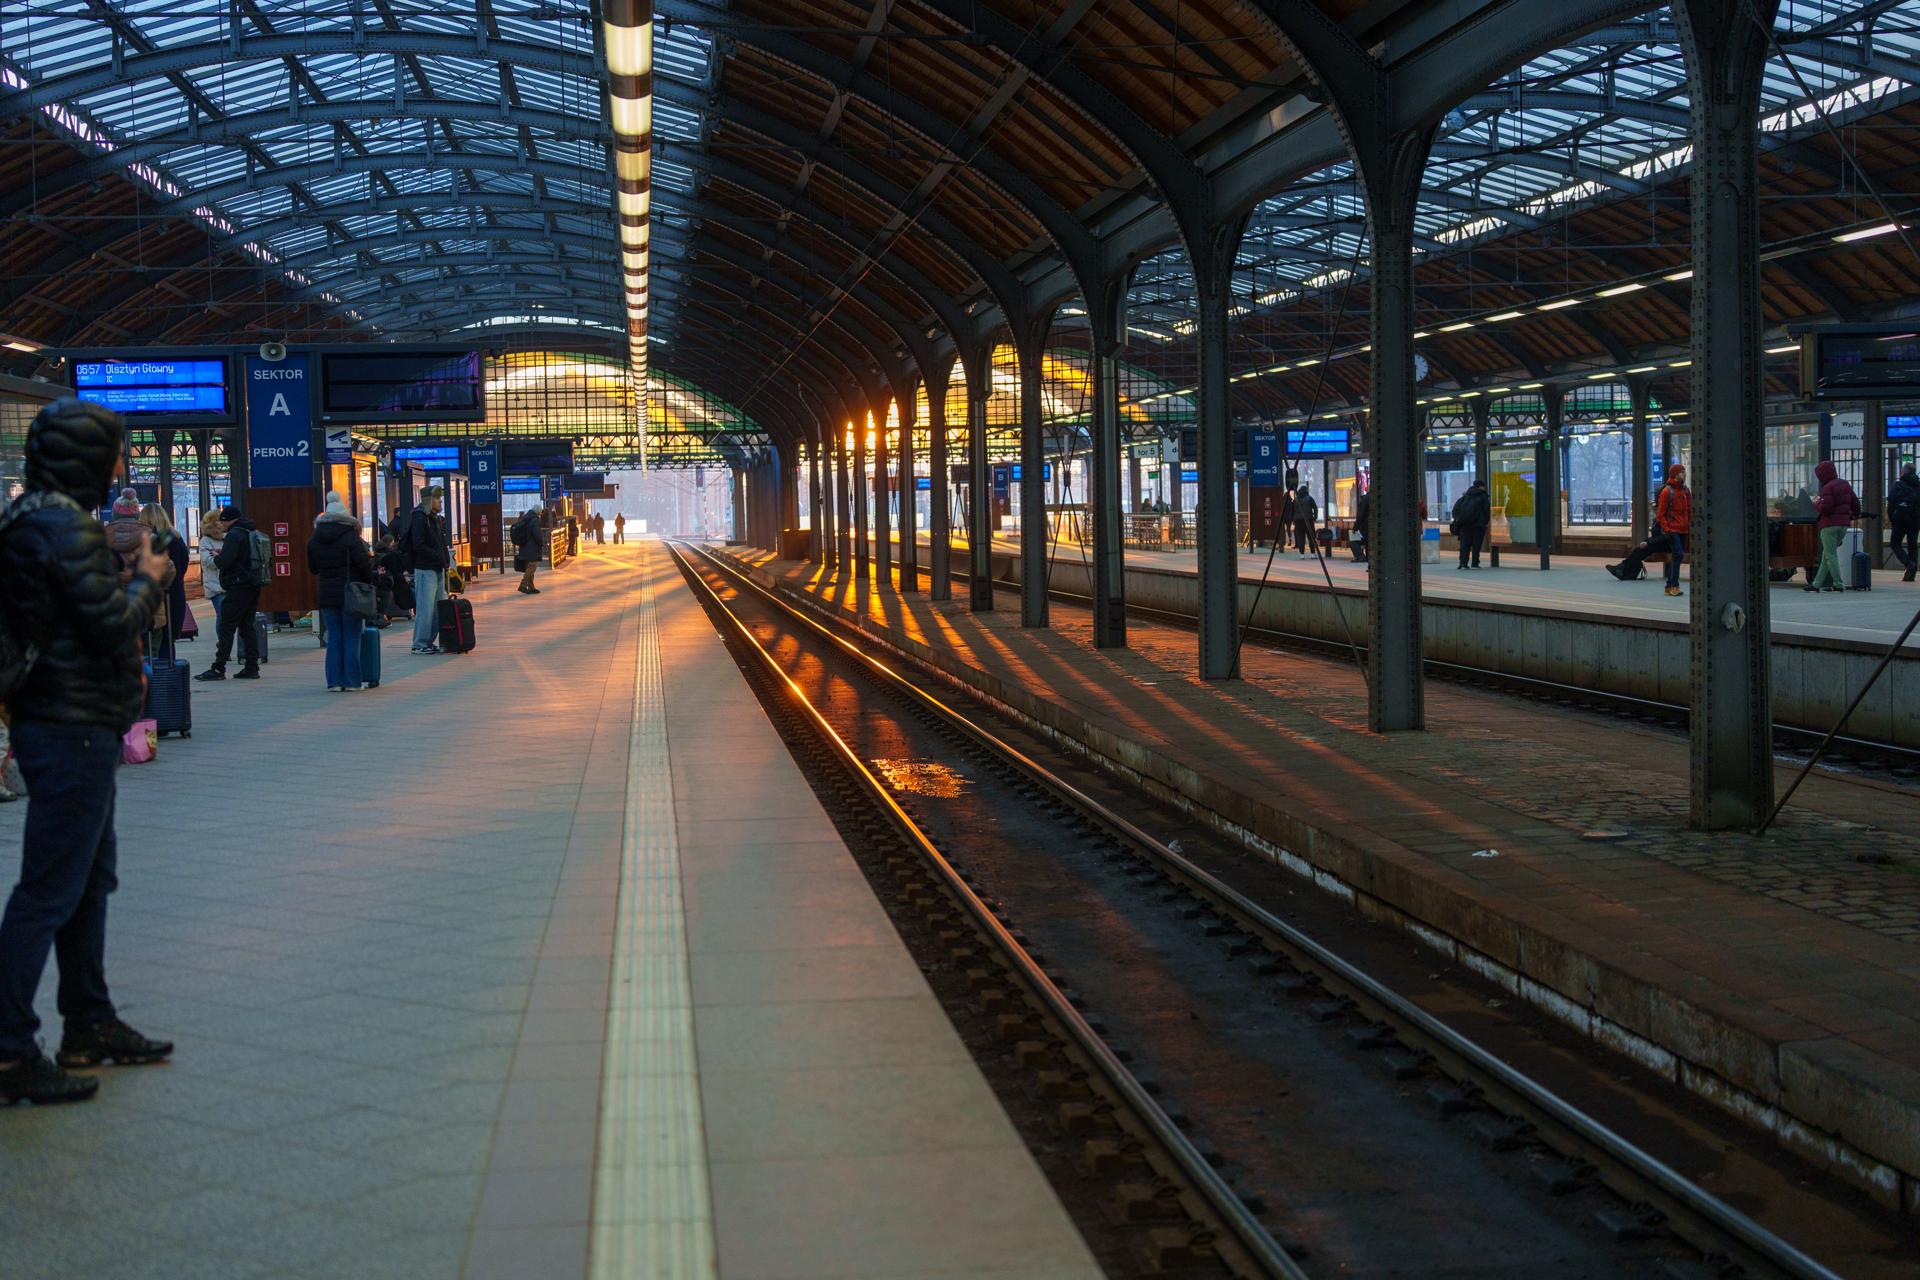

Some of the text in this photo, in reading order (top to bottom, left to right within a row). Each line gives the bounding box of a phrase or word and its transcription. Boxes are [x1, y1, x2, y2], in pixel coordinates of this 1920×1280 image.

[76, 365, 99, 375] 06:57
[106, 364, 140, 374] Olsztyn
[254, 370, 303, 380] SEKTOR
[269, 393, 290, 416] A
[254, 440, 309, 457] PERON 2
[1261, 446, 1270, 456] B
[478, 462, 488, 472] B
[1272, 466, 1278, 474] 3
[490, 482, 496, 490] 2
